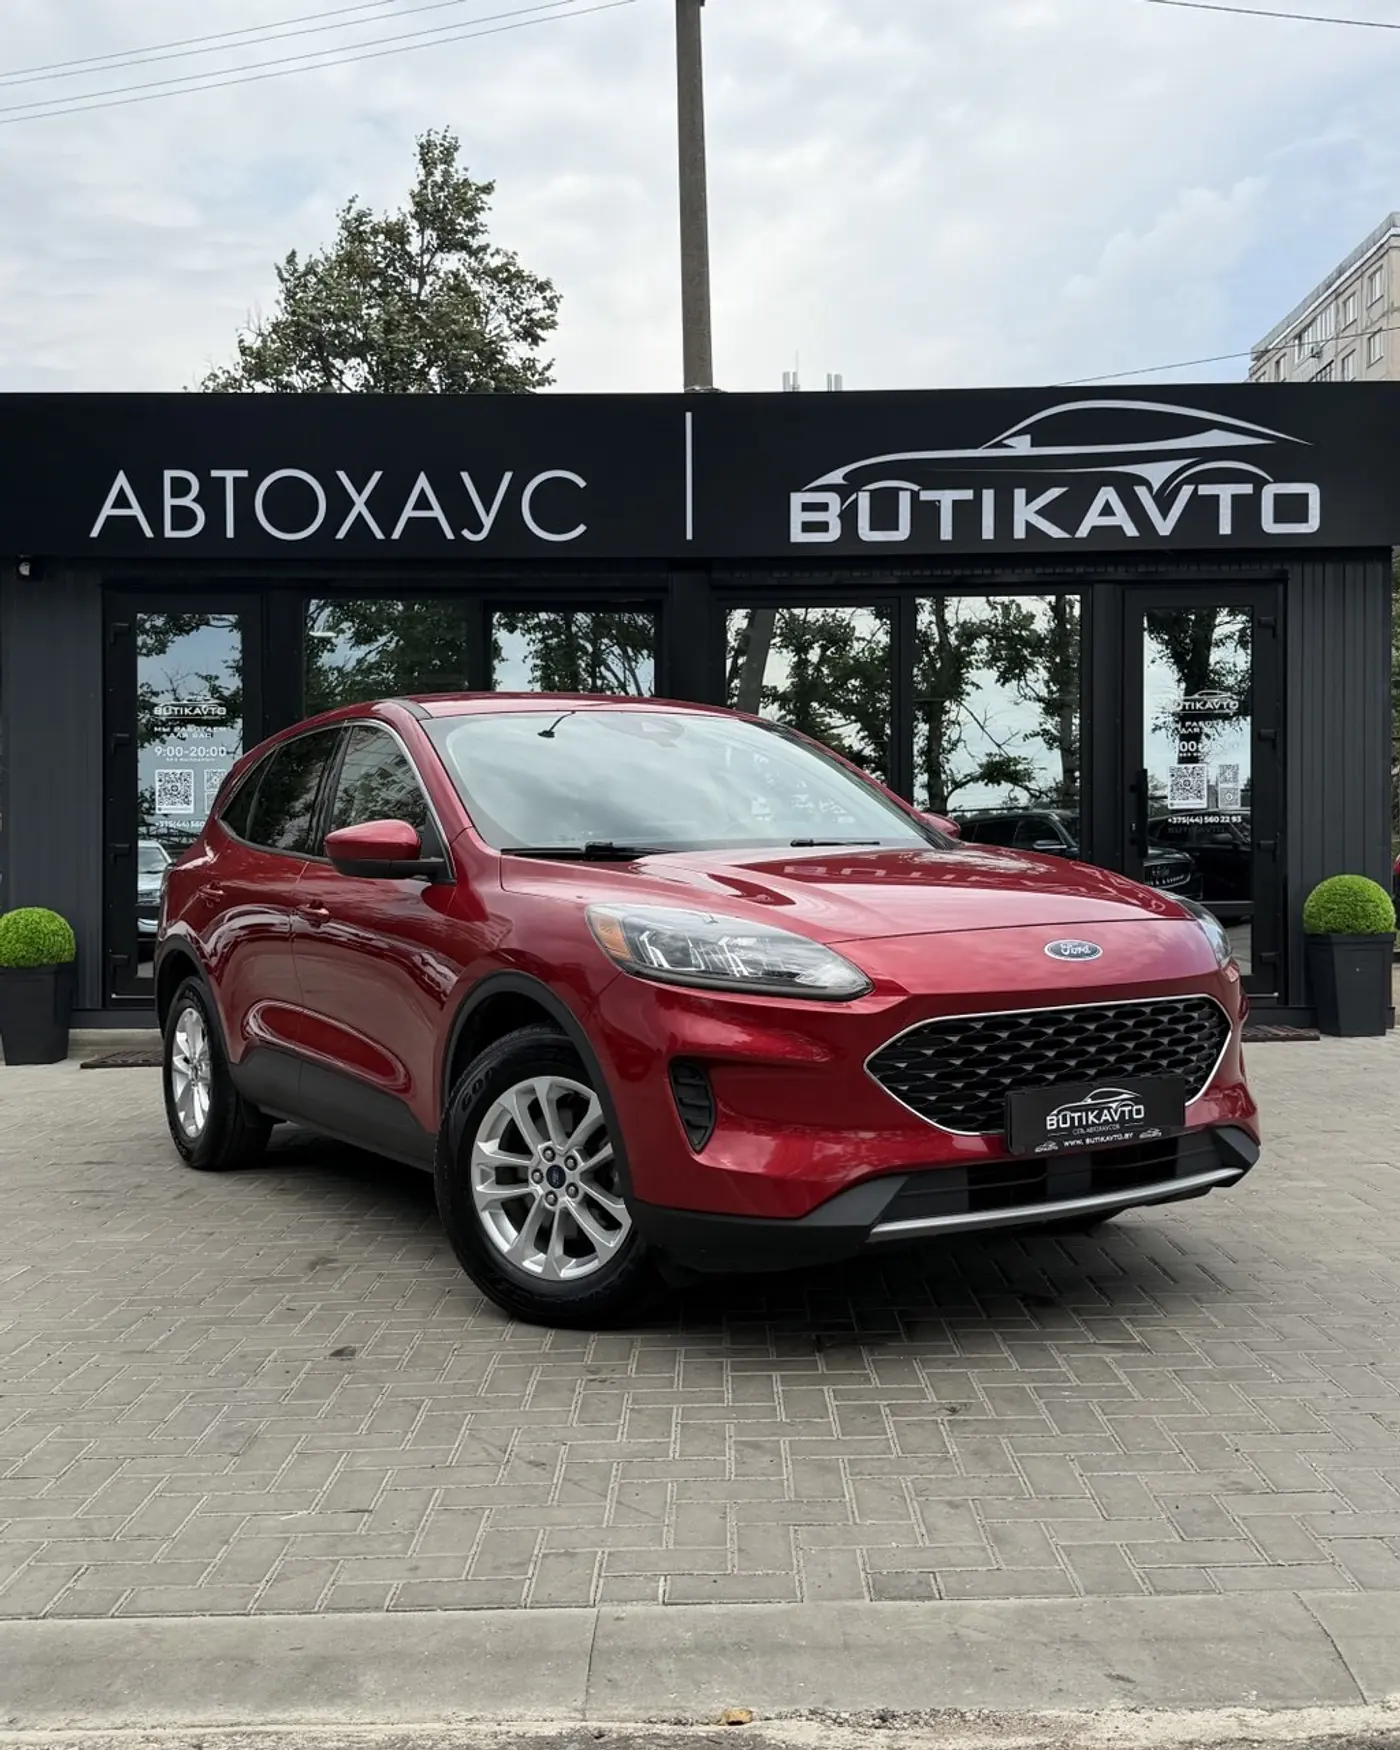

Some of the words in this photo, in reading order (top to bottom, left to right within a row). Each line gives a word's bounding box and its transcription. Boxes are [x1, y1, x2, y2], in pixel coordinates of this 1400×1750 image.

[89, 468, 588, 542] АВТОХАУС
[788, 482, 1321, 543] BUTIKAVTO
[153, 705, 227, 716] BUTIKAVTO
[1170, 700, 1239, 710] UTIKAVTO
[154, 746, 227, 757] 9:00-20:00
[1167, 816, 1203, 825] +375(44)
[1204, 816, 1219, 824] 560
[1220, 815, 1230, 823] 22
[1231, 815, 1242, 823] 93
[1059, 942, 1091, 956] Ford
[1045, 1105, 1145, 1130] BUTIKAVTO
